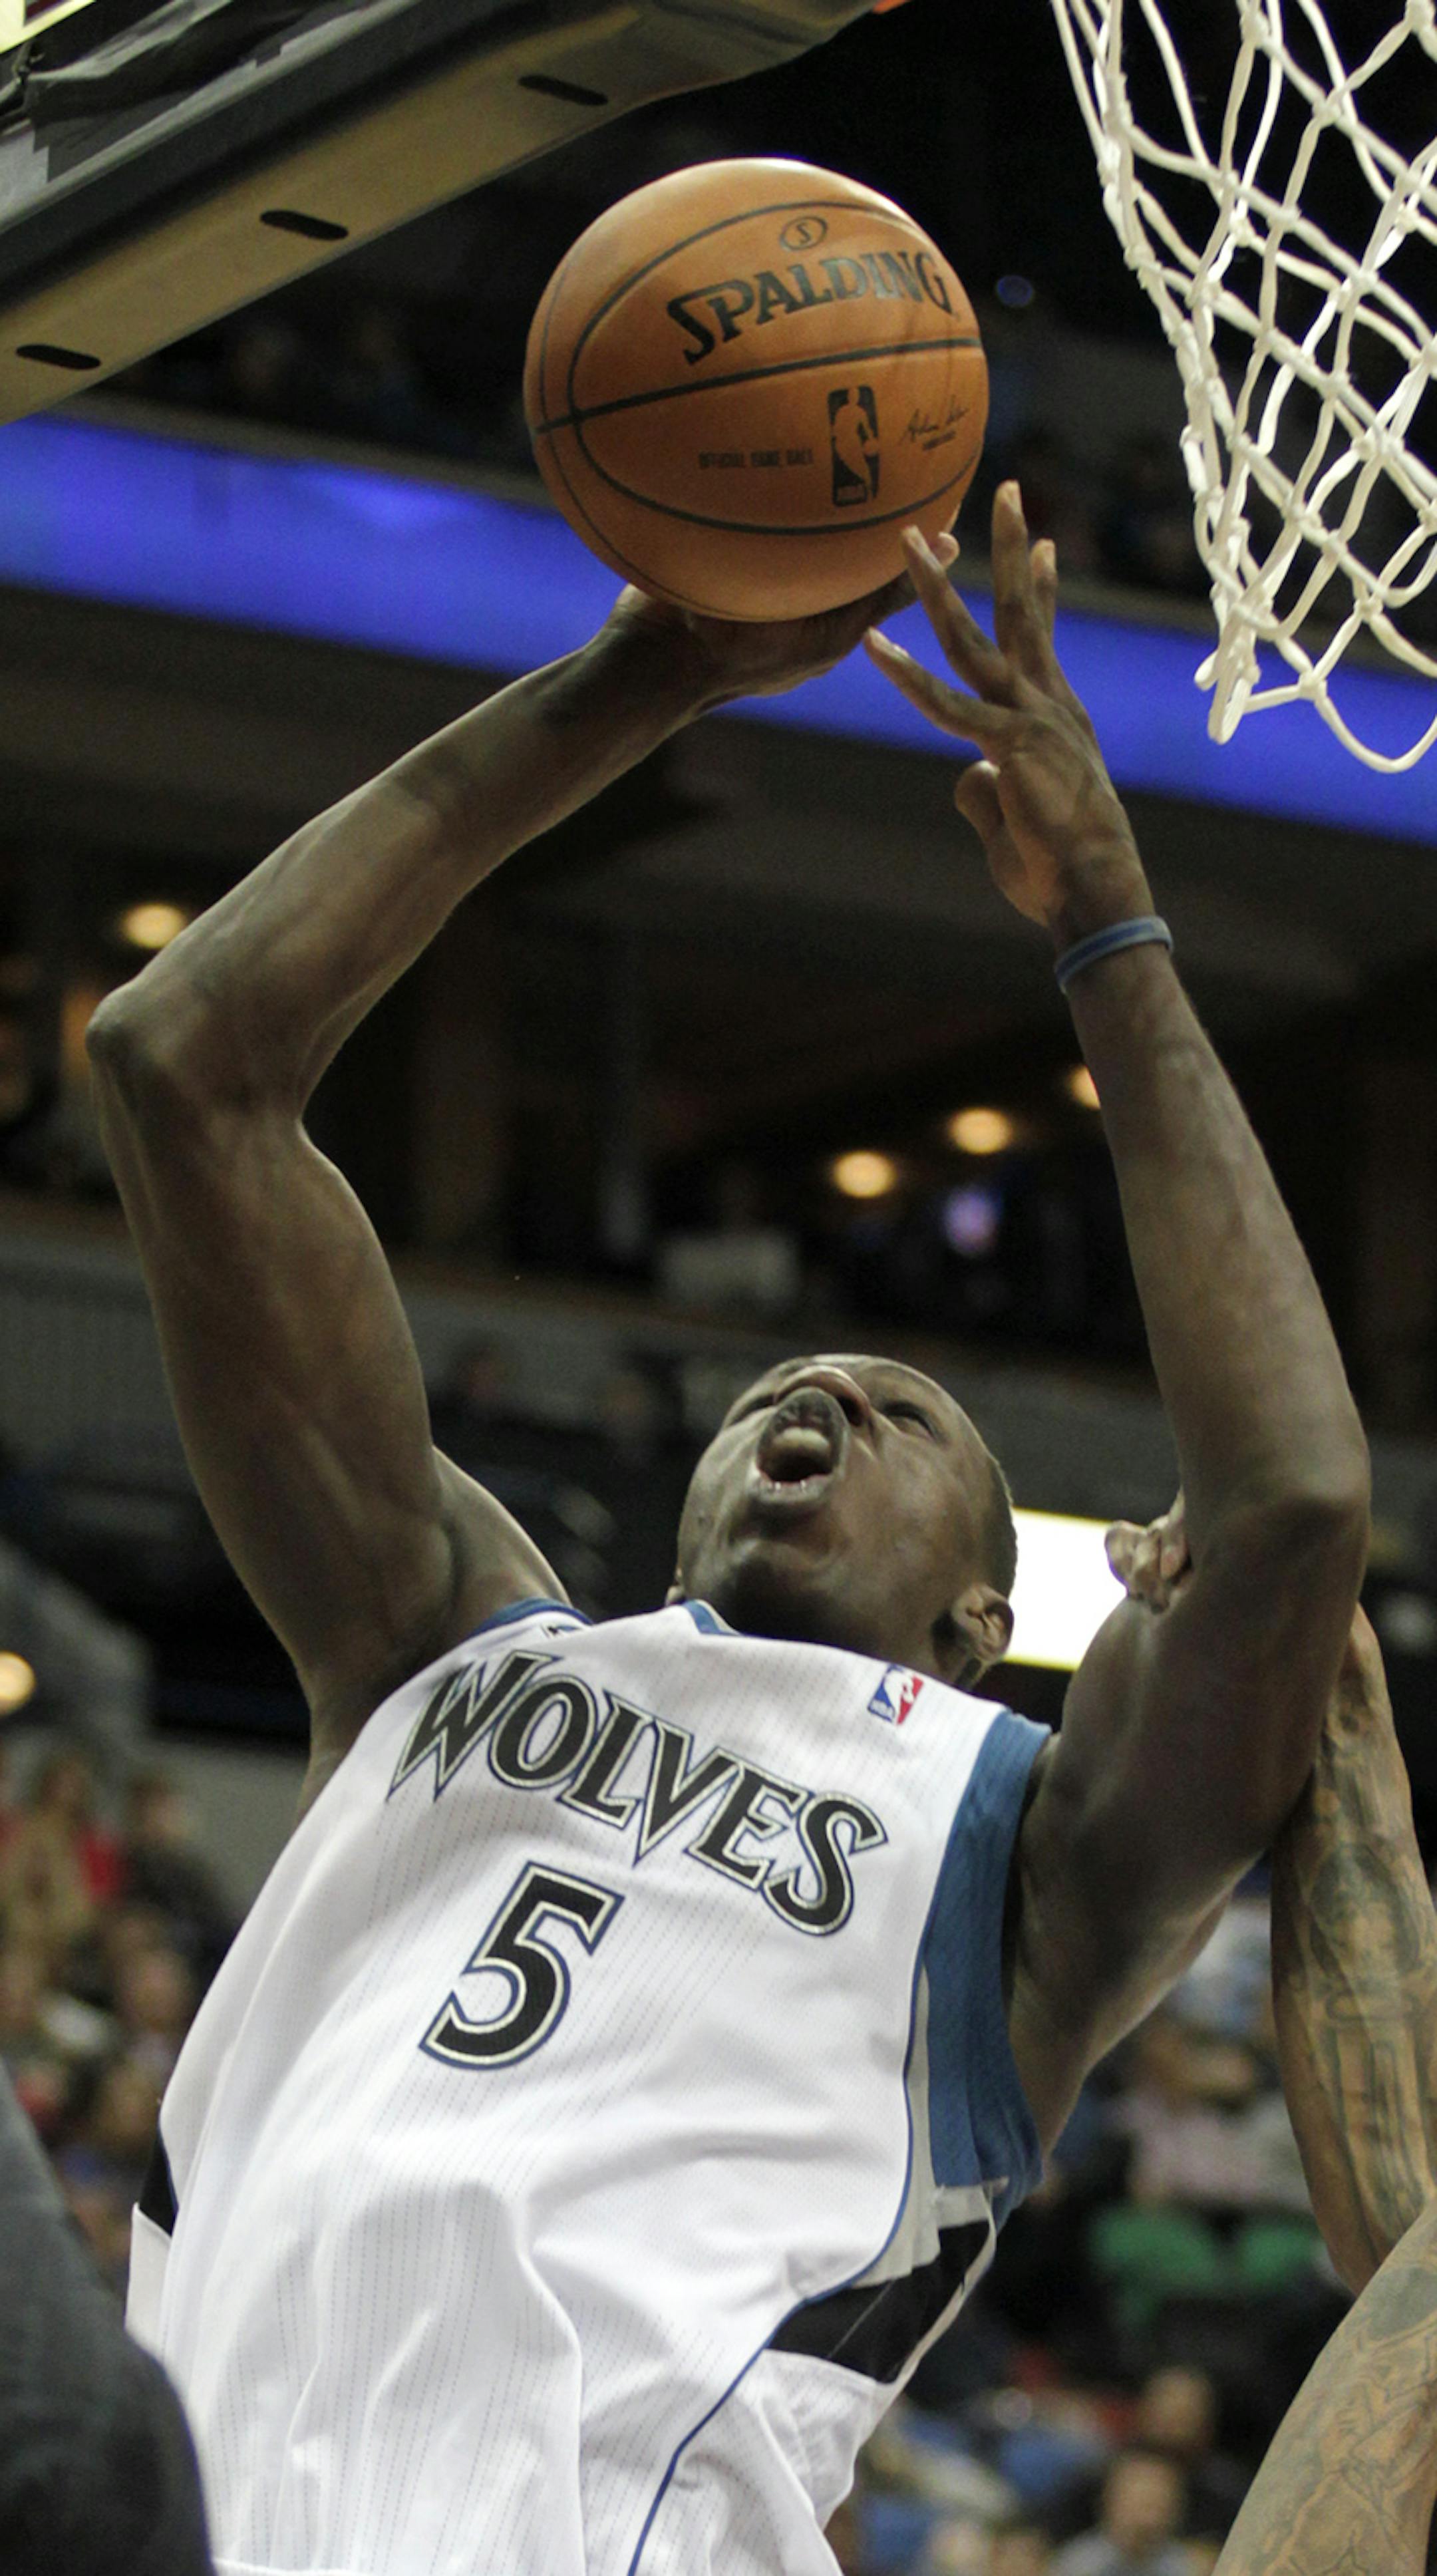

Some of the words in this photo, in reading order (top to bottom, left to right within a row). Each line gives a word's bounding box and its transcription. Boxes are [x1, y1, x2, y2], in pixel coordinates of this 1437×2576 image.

[667, 251, 953, 365] SPALDING
[386, 1649, 889, 1936] WOLVES
[418, 1860, 625, 2072] 5
